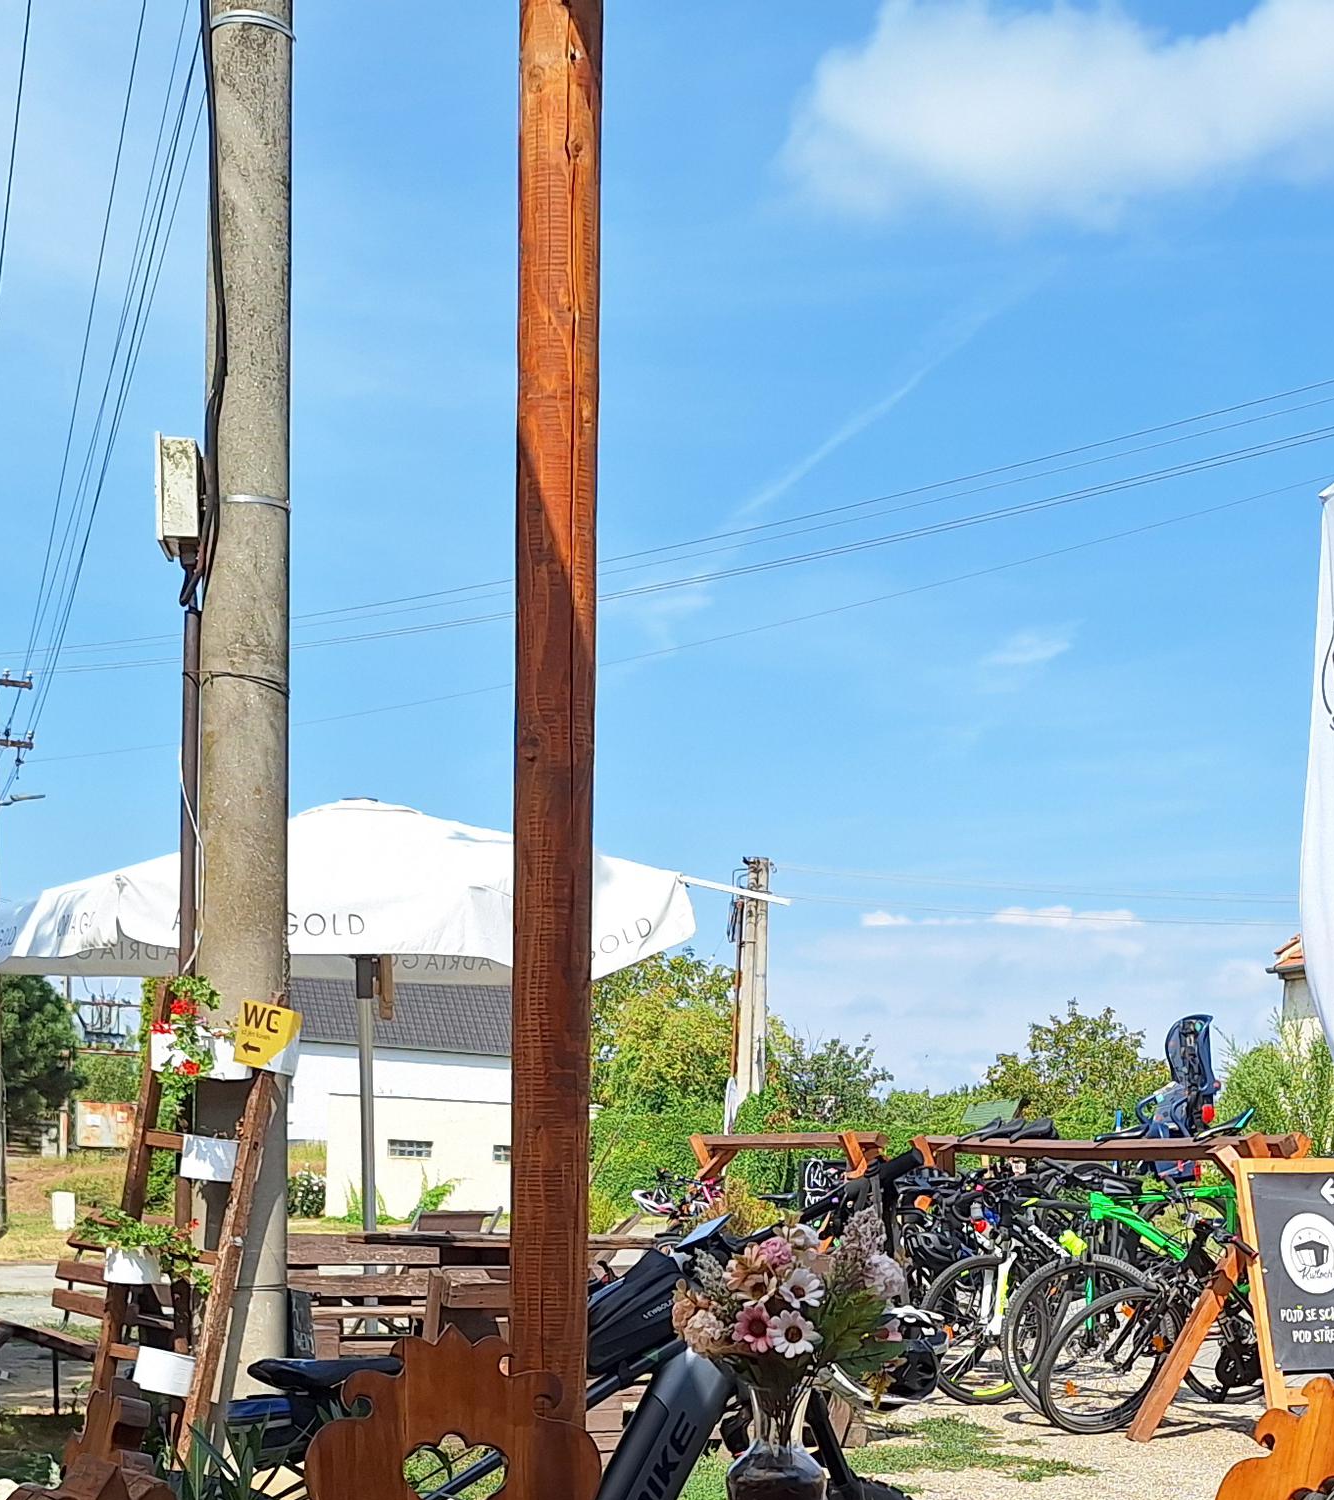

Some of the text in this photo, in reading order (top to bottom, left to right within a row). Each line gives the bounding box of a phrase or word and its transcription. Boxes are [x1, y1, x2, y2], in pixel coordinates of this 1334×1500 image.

[592, 917, 652, 960] OLD
[244, 1002, 282, 1034] WC
[1028, 1224, 1071, 1258] ROCKR
[1305, 1308, 1318, 1322] SE
[1292, 1329, 1312, 1343] POD
